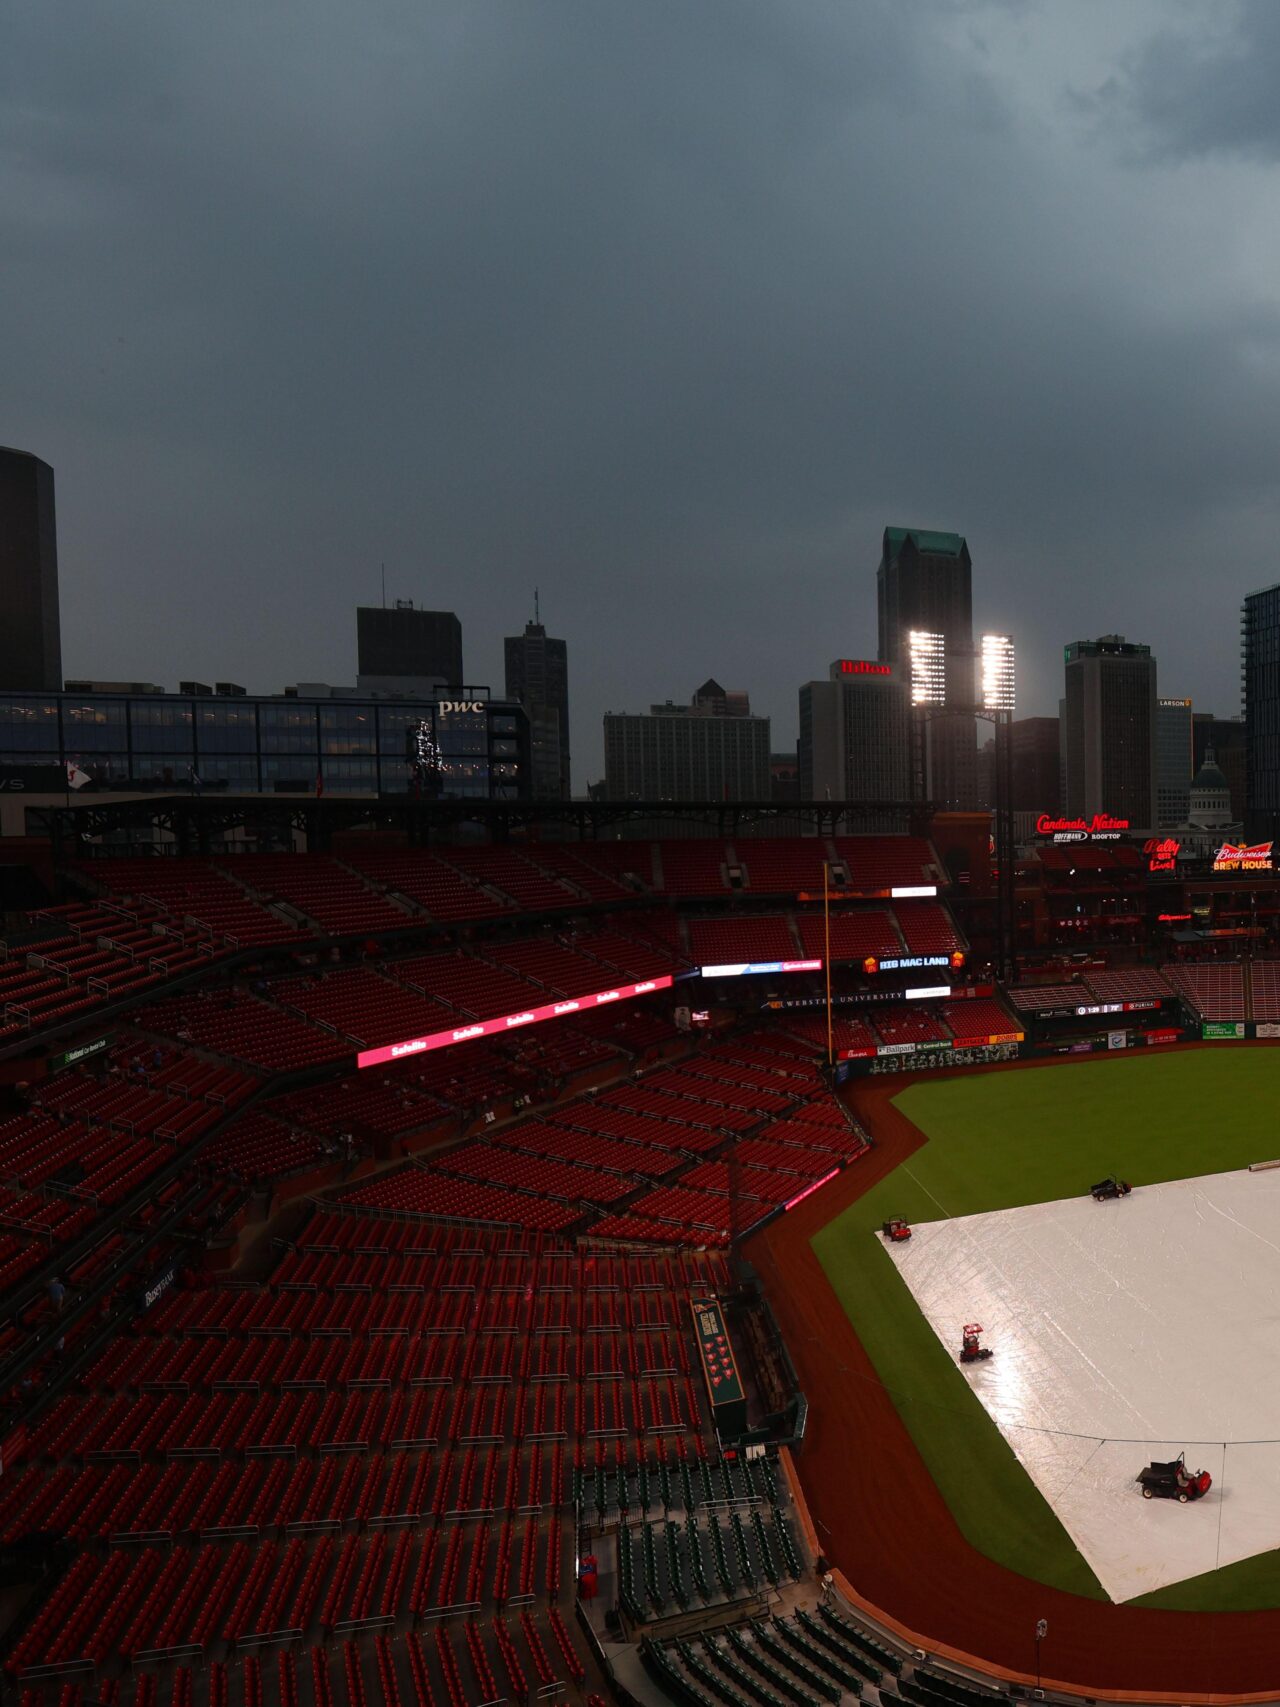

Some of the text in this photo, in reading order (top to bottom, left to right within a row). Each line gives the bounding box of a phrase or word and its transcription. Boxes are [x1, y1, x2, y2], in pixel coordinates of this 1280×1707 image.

[841, 660, 892, 675] Hilton
[437, 701, 485, 717] pwc
[1037, 811, 1129, 834] Cardinals Nation
[1214, 848, 1272, 860] Budweiser
[1149, 859, 1176, 872] Live!
[1214, 860, 1272, 870] BREW HOUSE
[879, 956, 949, 970] BIG MAC LAND
[841, 992, 903, 1003] UNIVERSITY
[391, 1040, 427, 1057] Safelite
[886, 1044, 915, 1055] Ballpark
